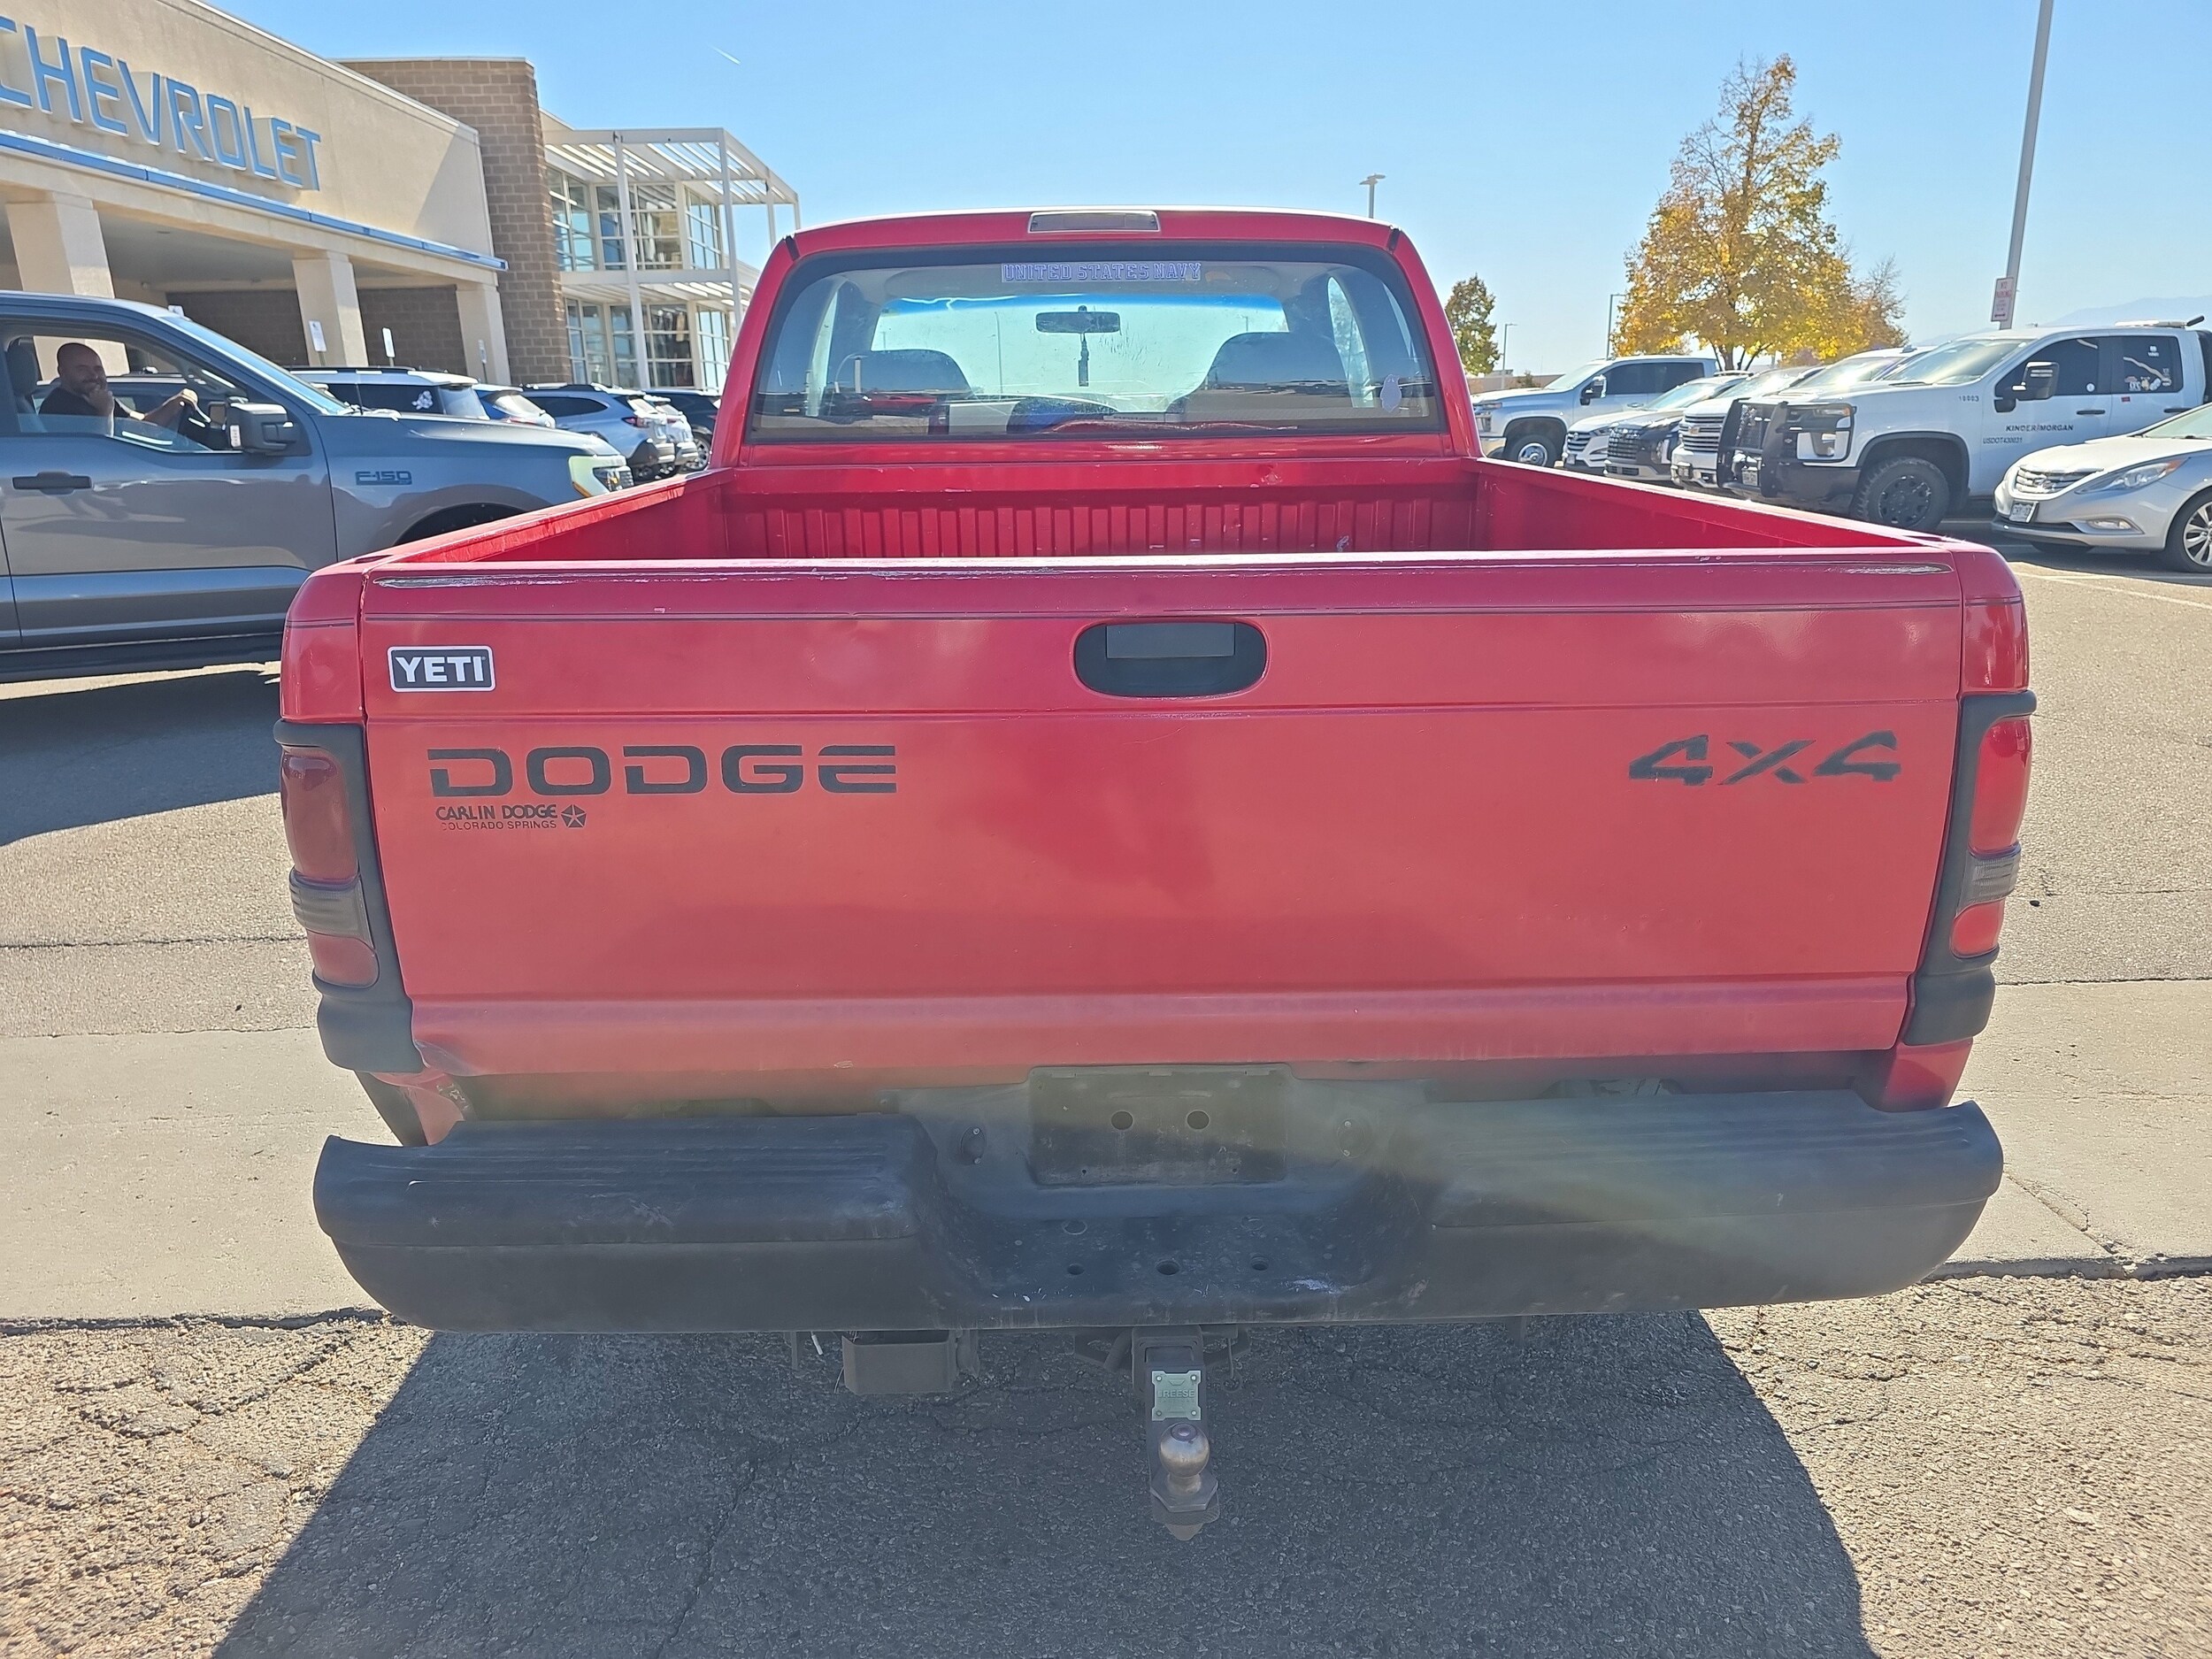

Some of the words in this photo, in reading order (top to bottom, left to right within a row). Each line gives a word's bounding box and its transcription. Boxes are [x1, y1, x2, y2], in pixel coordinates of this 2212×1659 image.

[0, 14, 321, 192] CHEVROLET
[1003, 265, 1073, 280] UNITED
[1077, 265, 1149, 280] STATES
[1153, 263, 1202, 280] NAVY
[356, 471, 412, 485] F-150
[395, 656, 484, 682] YETI
[427, 745, 897, 796] DODGE
[435, 805, 495, 820] CARLIN
[502, 804, 557, 819] DODGE
[507, 820, 557, 829] SPRINGS
[1163, 1389, 1195, 1398] REESE
